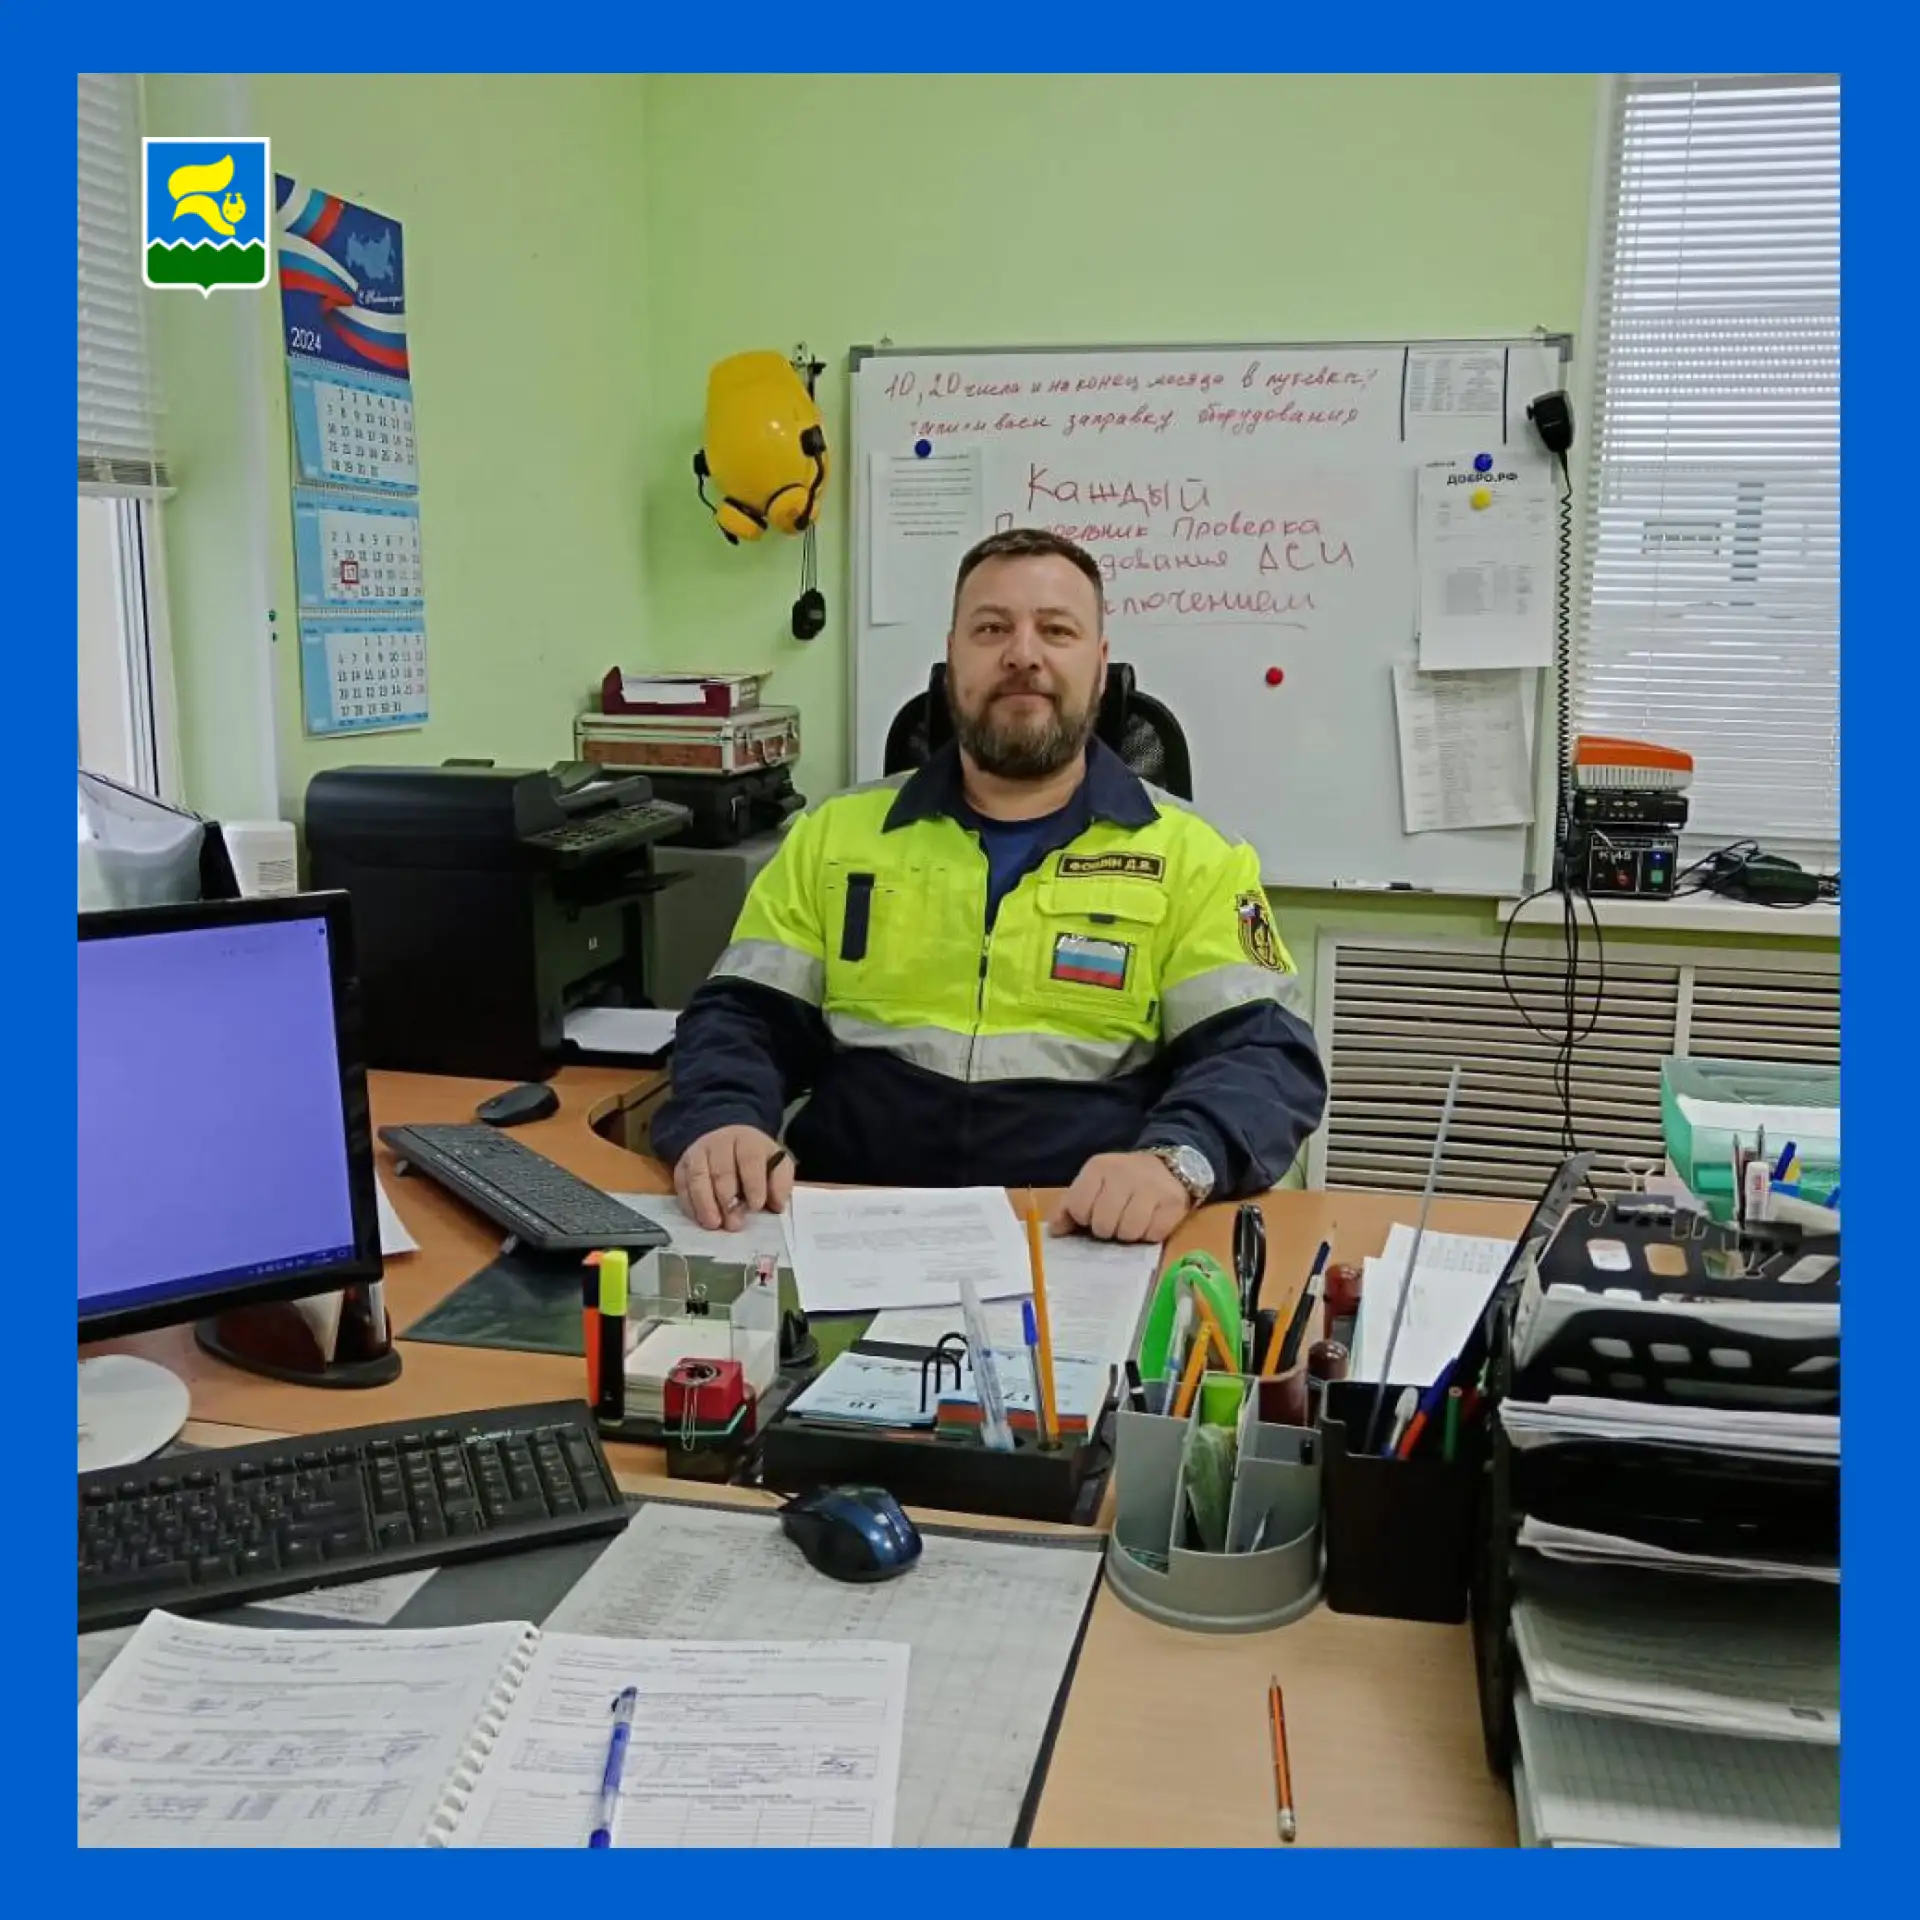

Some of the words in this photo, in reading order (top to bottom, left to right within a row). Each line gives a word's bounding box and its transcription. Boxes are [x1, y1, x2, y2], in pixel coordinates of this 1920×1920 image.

[290, 327, 322, 351] 2024
[928, 372, 960, 398] 20
[1062, 403, 1175, 438] заправку
[1028, 462, 1211, 516] Каждый
[1446, 471, 1519, 487] ДОБРО.РФ
[1172, 510, 1326, 542] Проверка
[1258, 541, 1355, 576] ДСИ
